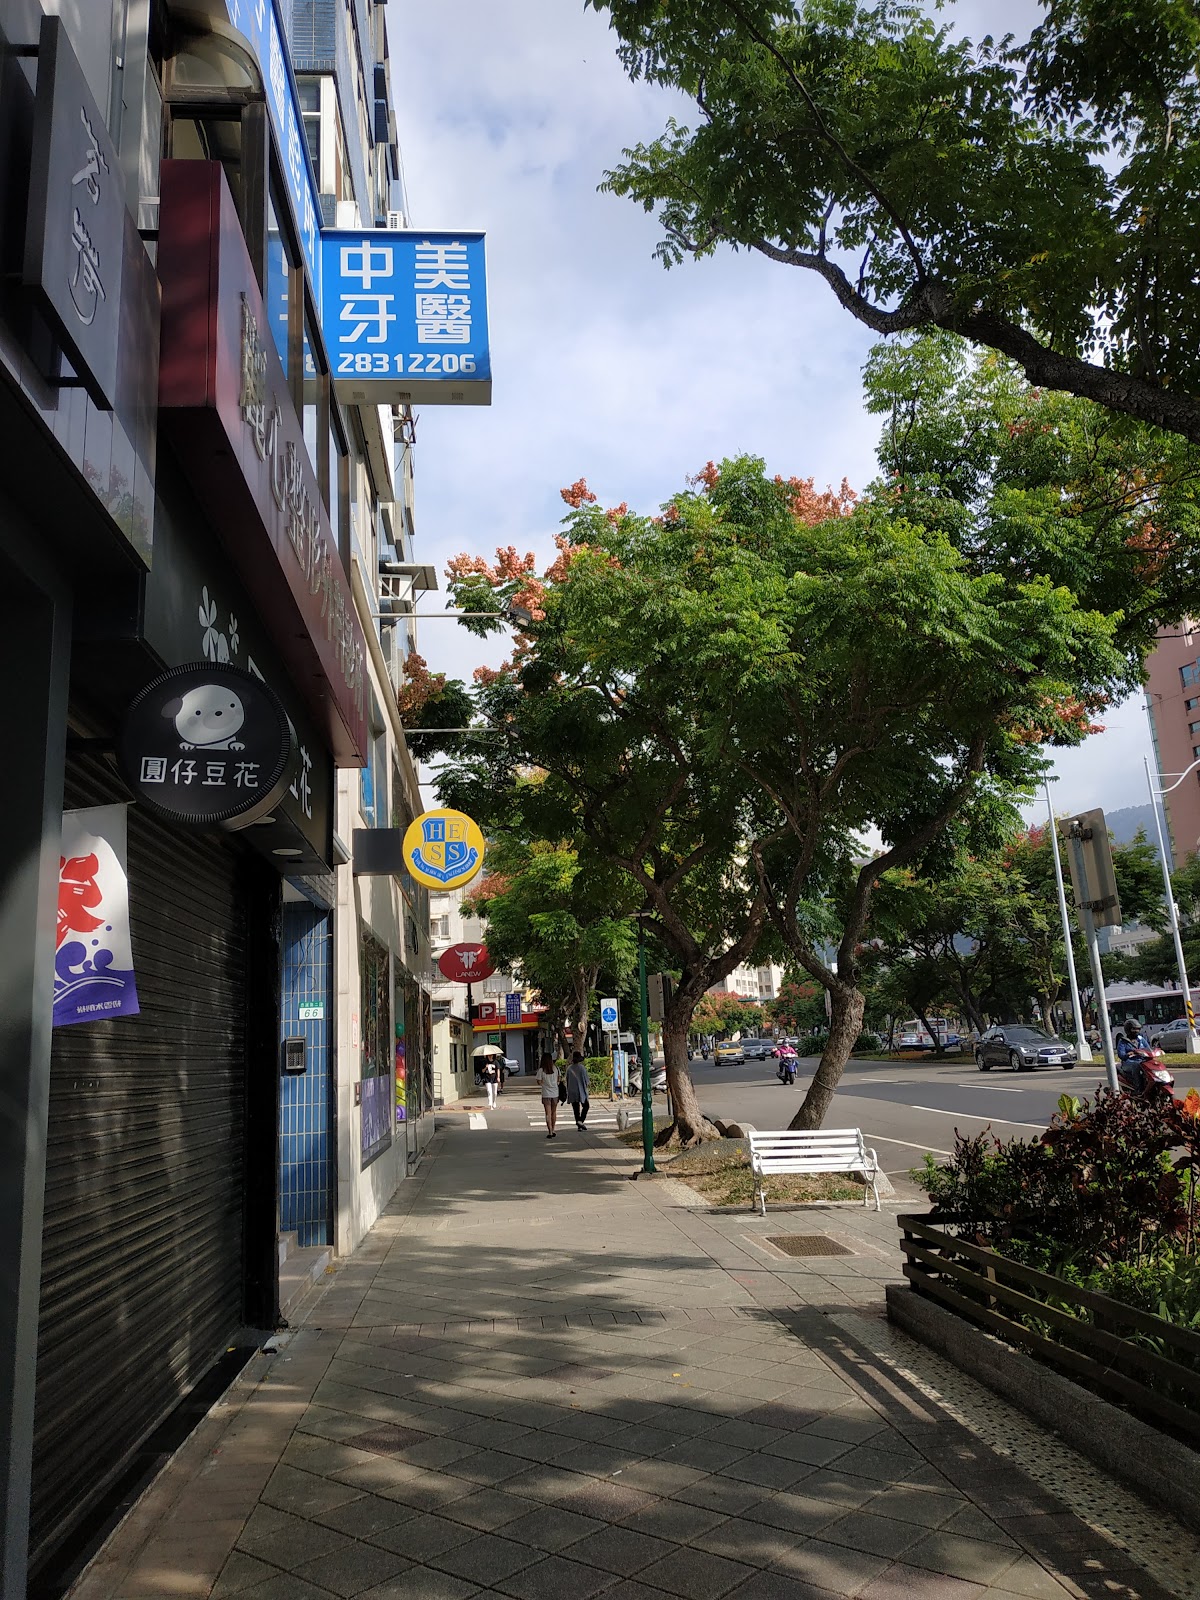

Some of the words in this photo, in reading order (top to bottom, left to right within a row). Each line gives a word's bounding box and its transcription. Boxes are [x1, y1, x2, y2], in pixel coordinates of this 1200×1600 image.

[340, 240, 471, 290] 中美
[339, 293, 472, 344] 牙醫
[338, 353, 476, 373] 28312206
[140, 756, 261, 788] 圓仔豆花
[304, 1008, 318, 1018] 66
[481, 1006, 493, 1018] P
